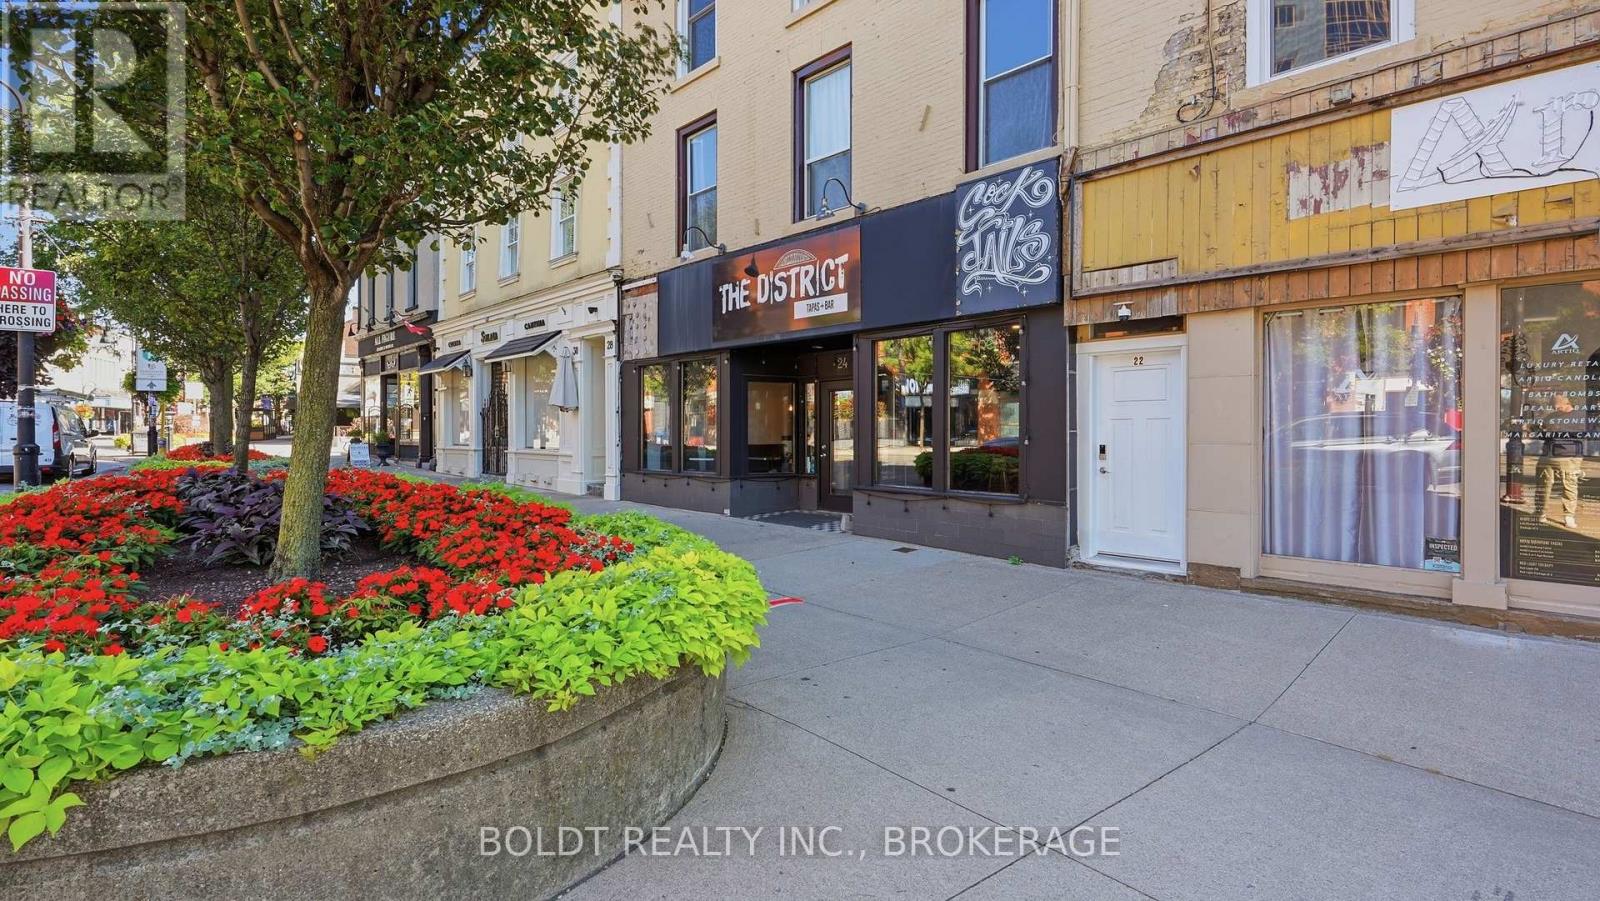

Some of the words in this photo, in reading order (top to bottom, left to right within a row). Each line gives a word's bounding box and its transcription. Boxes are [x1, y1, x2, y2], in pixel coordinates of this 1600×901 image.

[10, 270, 36, 286] NO
[719, 278, 751, 315] THE
[757, 253, 849, 305] DISTRICT
[0, 285, 52, 302] ASSING
[32, 305, 47, 316] TO
[806, 302, 820, 313] TAPAS
[824, 299, 835, 310] BAR
[0, 315, 51, 328] ROSSING
[606, 340, 614, 350] 28
[837, 356, 849, 369] 24
[1133, 356, 1144, 366] 22
[1520, 361, 1565, 369] LUXURY
[1570, 360, 1600, 368] RETA
[1429, 543, 1457, 551] INSPECTED
